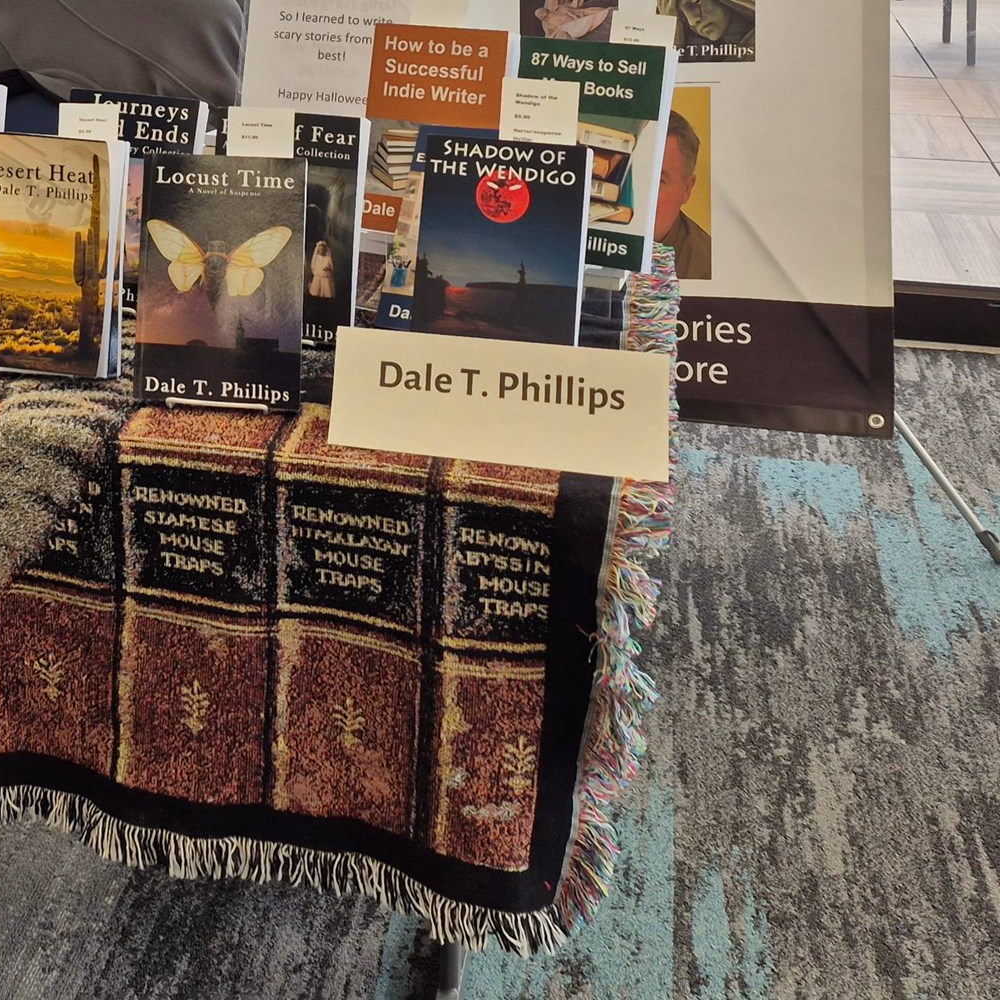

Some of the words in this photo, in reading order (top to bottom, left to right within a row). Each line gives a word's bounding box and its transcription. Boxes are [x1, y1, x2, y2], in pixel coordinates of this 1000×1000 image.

[274, 29, 302, 42] scary
[305, 30, 342, 43] stories
[345, 32, 372, 44] from
[384, 35, 424, 54] How
[428, 37, 446, 55] to
[451, 41, 473, 57] be
[478, 45, 489, 58] a
[318, 49, 346, 61] best!
[385, 58, 484, 82] Successful
[278, 88, 312, 102] Happy
[383, 81, 425, 100] Indie
[431, 84, 486, 106] Writer
[136, 121, 189, 144] Ends
[311, 125, 357, 146] Fear
[296, 147, 350, 161] Collection
[443, 138, 535, 162] SHADOW
[540, 149, 566, 166] OF
[50, 164, 94, 184] Heat
[156, 166, 228, 187] Locust
[237, 169, 295, 190] Time
[430, 159, 468, 177] THE
[476, 162, 576, 186] WENDIGO
[26, 185, 39, 197] T.
[46, 187, 94, 203] Phillips
[379, 361, 452, 393] Dale
[460, 368, 488, 398] T.
[499, 371, 625, 415] Phillips
[135, 486, 249, 514] RENOWNED
[144, 511, 238, 535] SIAMESE
[291, 504, 410, 536] RENOWNED
[160, 532, 225, 556] MOUSE
[161, 552, 224, 576] TRAPS
[453, 550, 551, 576] ABYSSIN
